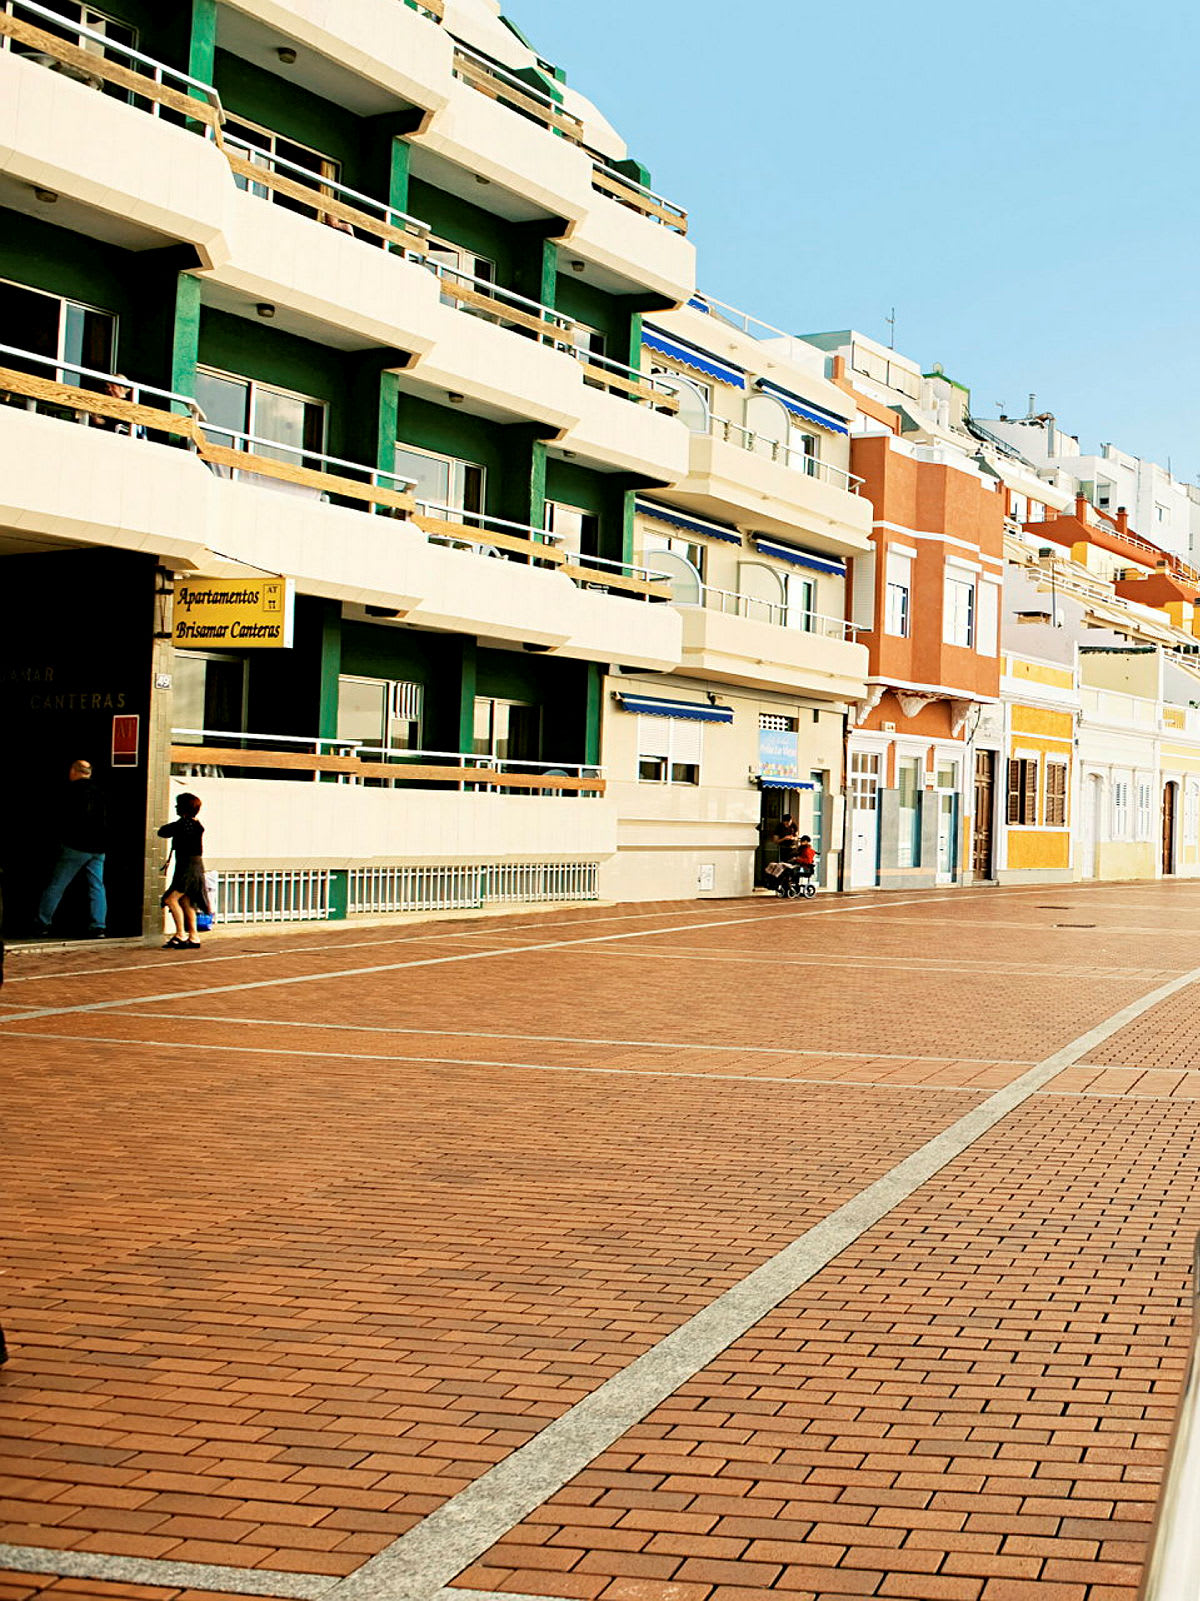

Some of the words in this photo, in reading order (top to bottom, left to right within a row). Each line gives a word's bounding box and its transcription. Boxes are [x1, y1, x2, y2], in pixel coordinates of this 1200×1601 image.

[177, 587, 260, 612] Apartamentos
[176, 621, 229, 638] Brisamar
[231, 621, 280, 638] Canteras
[31, 692, 127, 710] CANTERAS
